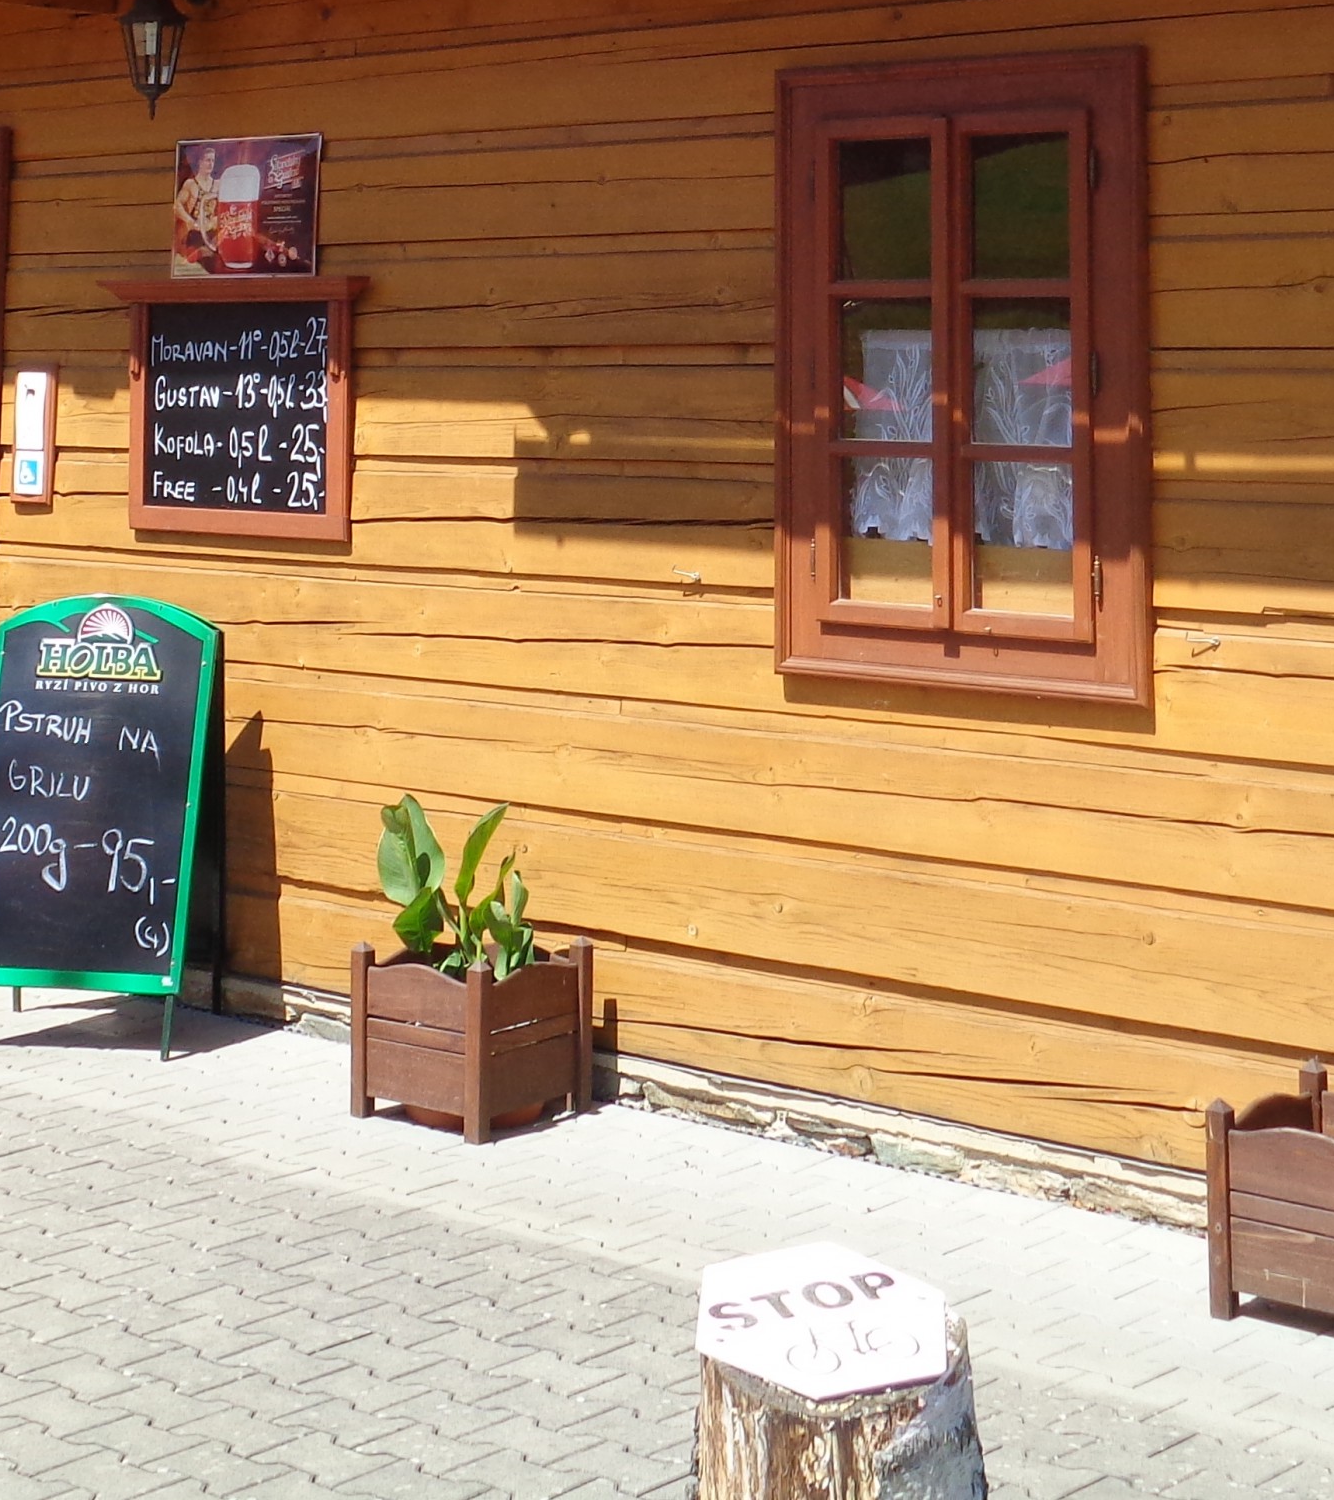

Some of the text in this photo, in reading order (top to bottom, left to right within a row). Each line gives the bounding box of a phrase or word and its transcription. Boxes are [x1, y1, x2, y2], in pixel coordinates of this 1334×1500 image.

[153, 471, 196, 502] FREE
[37, 639, 162, 679] HOLBA
[74, 681, 108, 692] PIVO
[112, 683, 122, 693] Z
[128, 683, 160, 695] HOR
[118, 725, 161, 772] NA
[708, 1272, 895, 1330] STOP
